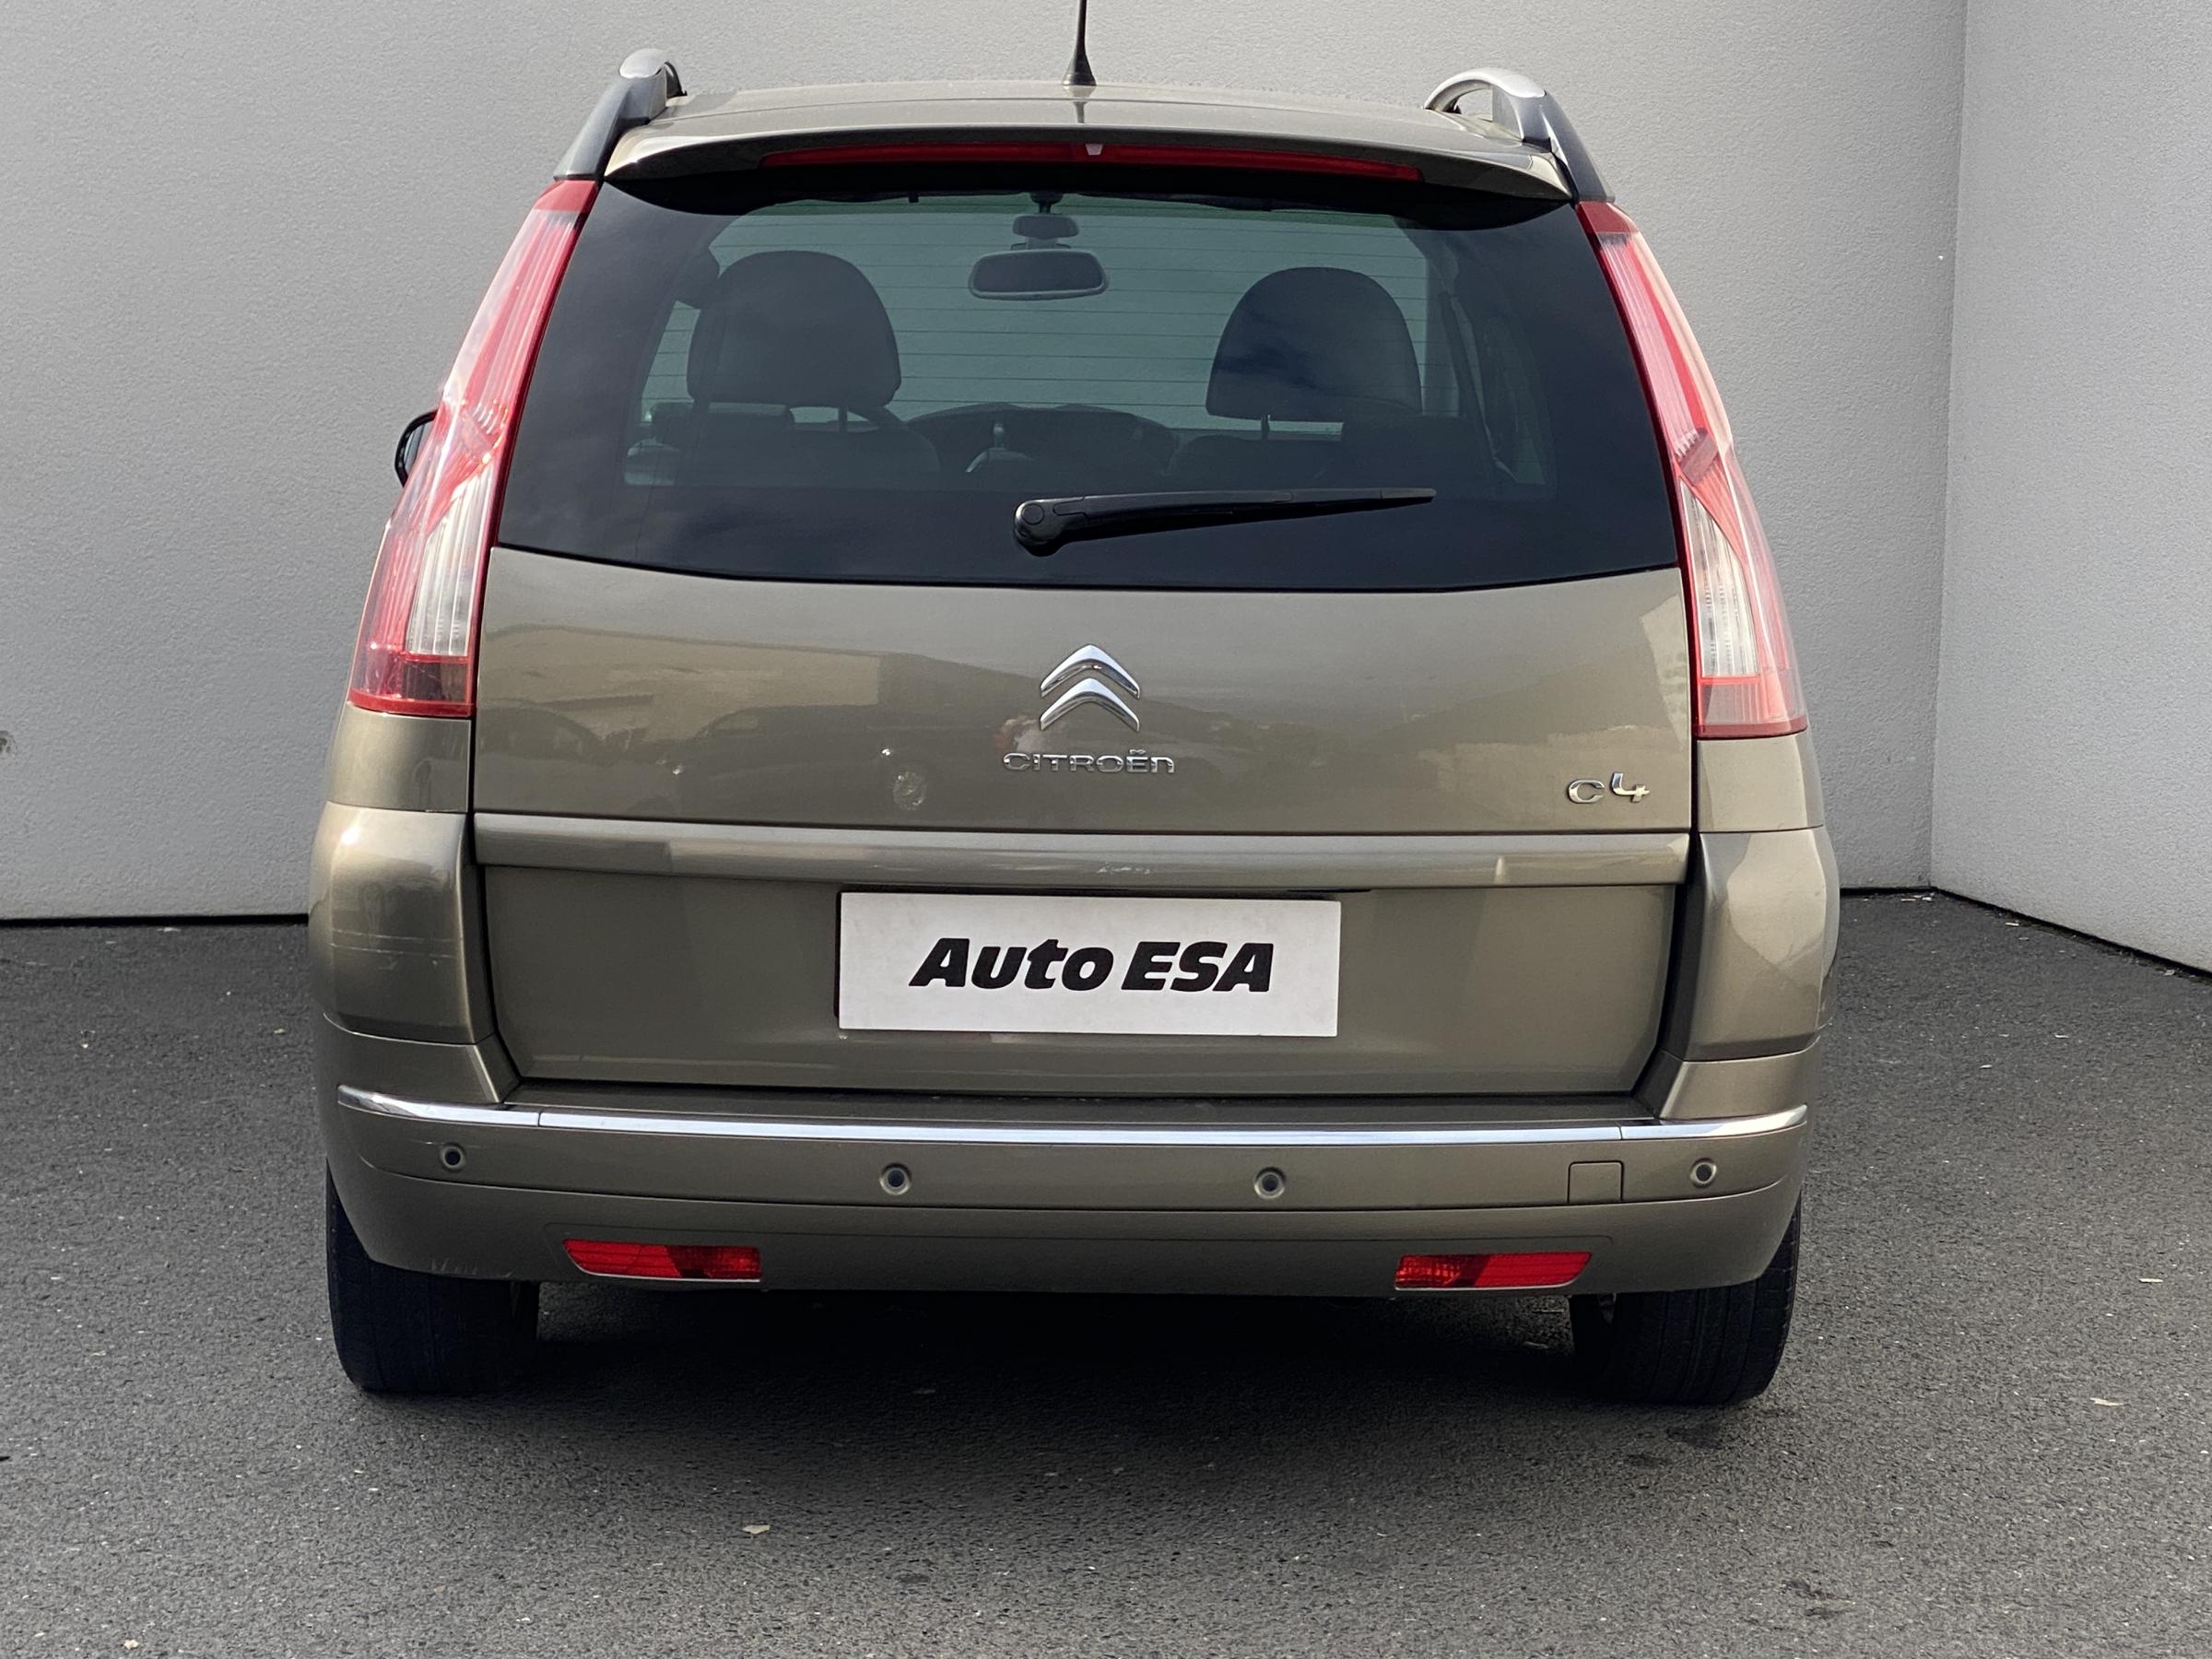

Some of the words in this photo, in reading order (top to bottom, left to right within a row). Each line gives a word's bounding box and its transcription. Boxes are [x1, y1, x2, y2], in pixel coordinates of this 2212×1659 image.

[1568, 771, 1650, 804] C4
[908, 937, 1114, 991] Auto
[1121, 941, 1275, 993] ESA
